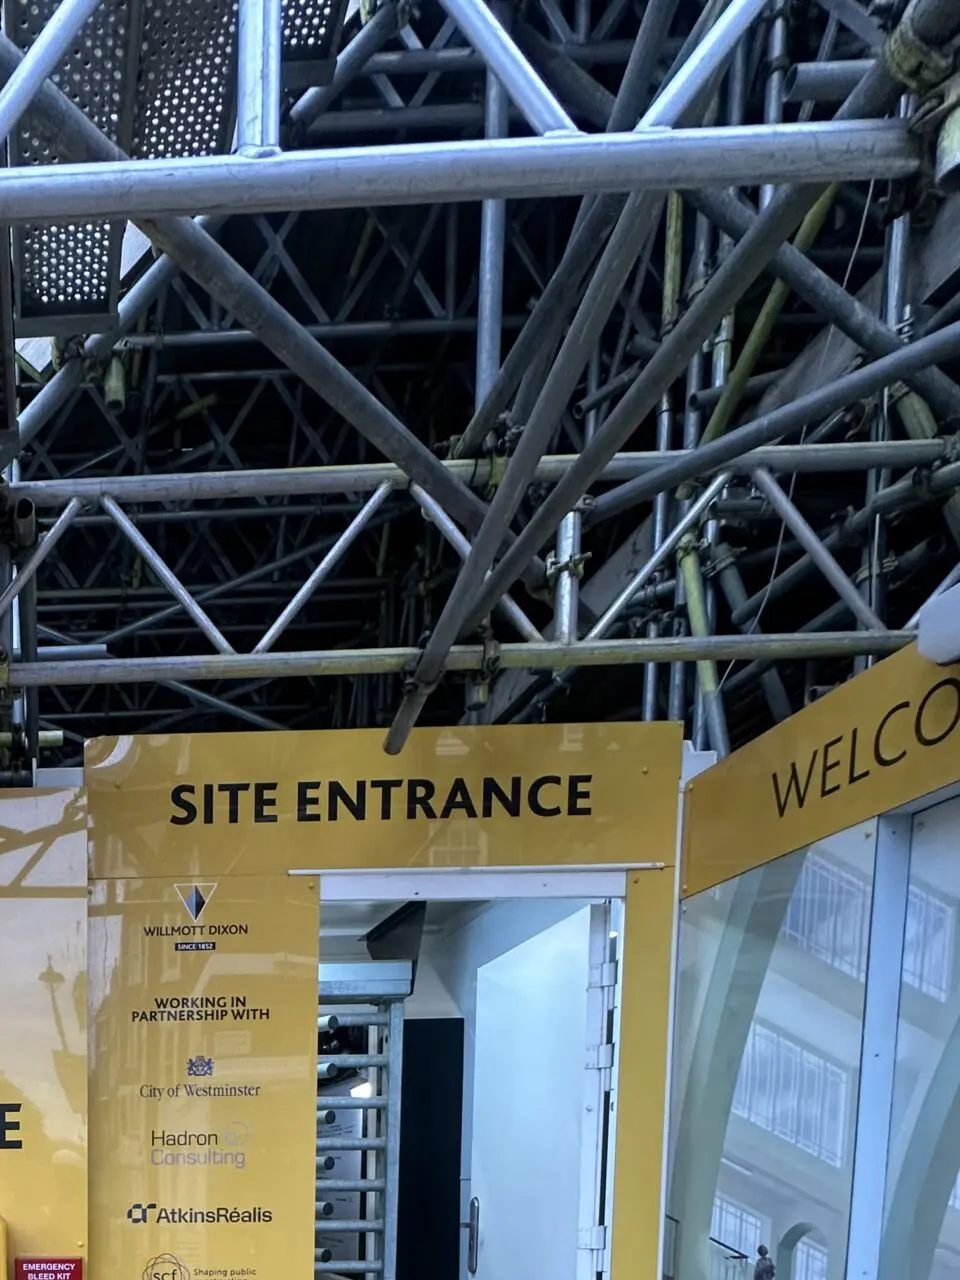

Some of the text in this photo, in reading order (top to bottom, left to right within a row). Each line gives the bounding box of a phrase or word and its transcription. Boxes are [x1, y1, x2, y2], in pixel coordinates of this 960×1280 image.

[170, 774, 593, 826] SITE ENTRANCE
[143, 924, 248, 937] WILLMOTT DIXON
[176, 943, 197, 951] SINCE
[155, 996, 247, 1010] WORKING IN
[131, 1007, 271, 1023] PARTNERSHIP WITH
[139, 1083, 262, 1101] City of Westminster
[151, 1130, 219, 1147] Hadron
[150, 1149, 246, 1169] Consulting
[156, 1207, 273, 1224] AtkinsRéalis
[22, 1263, 76, 1271] EMERGENCY
[193, 1268, 257, 1277] Shaping public
[27, 1272, 71, 1280] BLEED KIT
